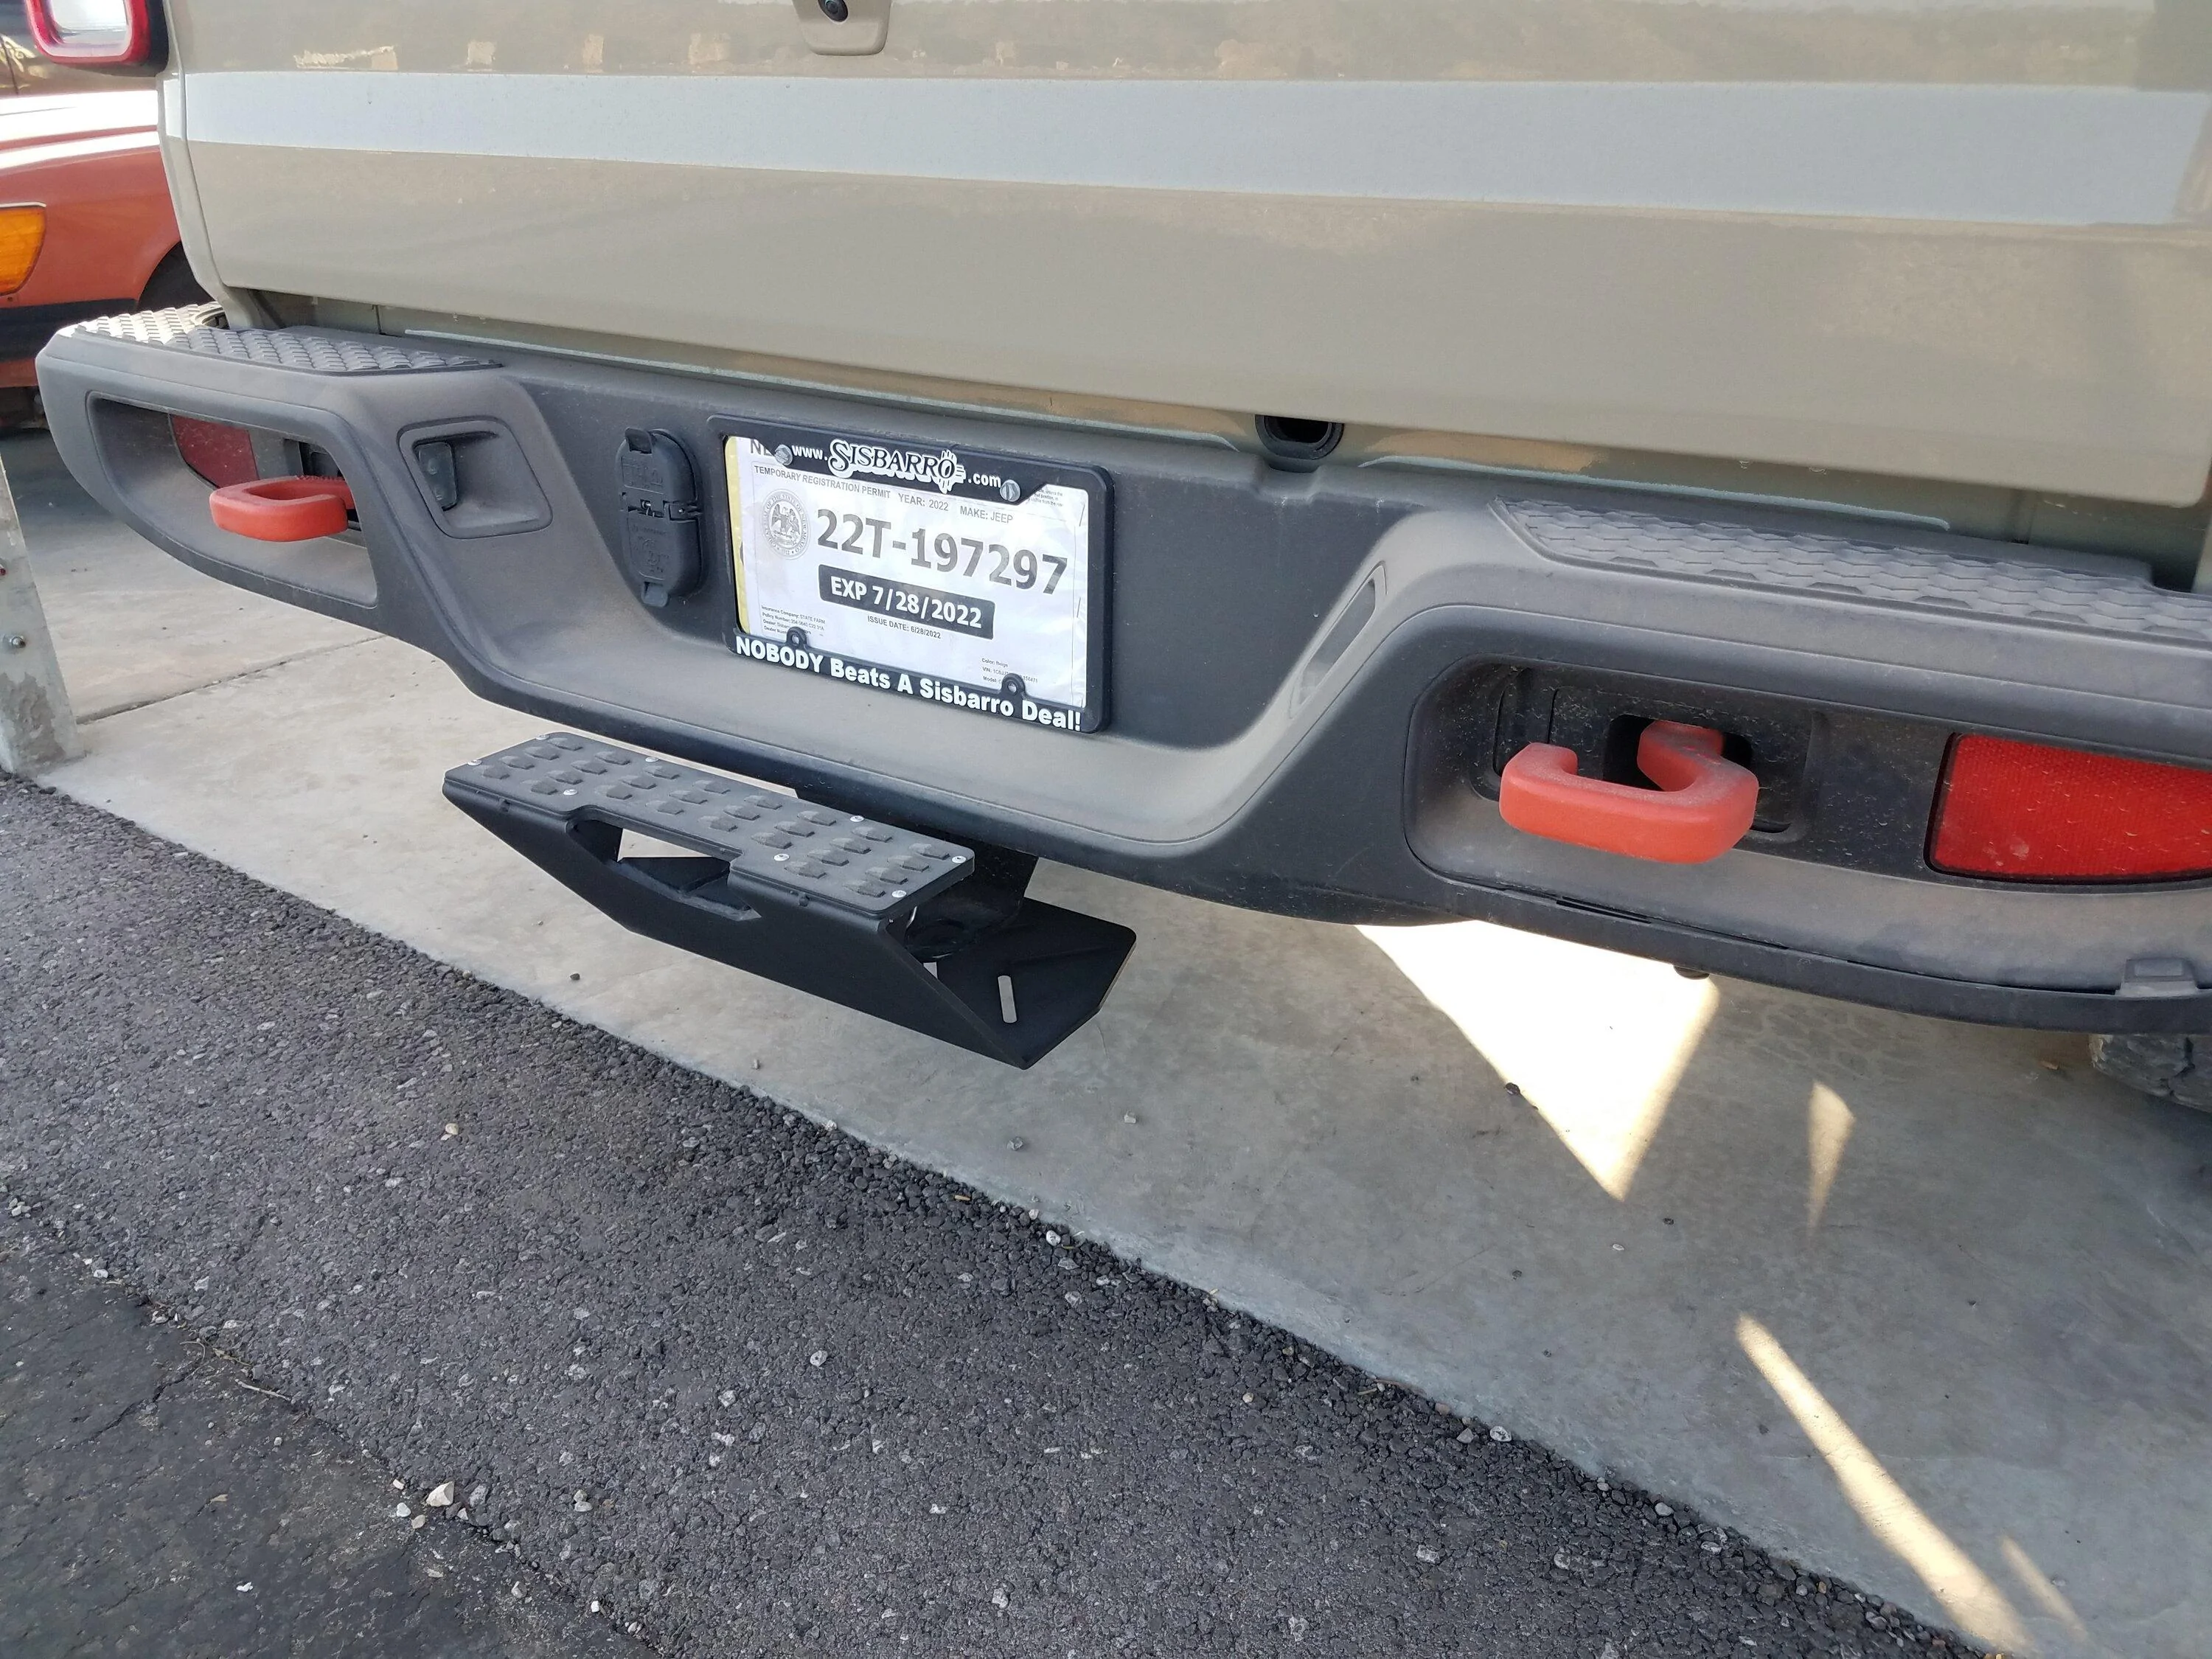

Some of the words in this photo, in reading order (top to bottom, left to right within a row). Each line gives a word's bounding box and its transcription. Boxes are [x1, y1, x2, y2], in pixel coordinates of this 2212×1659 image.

[754, 465, 801, 481] TEMPORARY
[802, 474, 860, 493] REGISTRATION
[862, 486, 891, 498] PERMIT
[898, 493, 925, 507] YEAR:
[929, 499, 949, 512] 2022
[960, 505, 988, 519] MAKE:
[990, 511, 1013, 524] JEEP
[817, 509, 1068, 594] 22T-197297
[761, 605, 780, 613] Insurance
[830, 576, 867, 601] EXP
[872, 585, 982, 628] 7/28/2022
[867, 615, 888, 626] ISSUE
[889, 621, 909, 632] DATE:
[911, 626, 942, 639] 6/28/2022
[736, 636, 824, 673] NOBODY
[830, 658, 891, 689] Beats
[897, 673, 914, 695] A
[919, 678, 1014, 717] Sisbarro
[1022, 700, 1081, 731] Deal!
